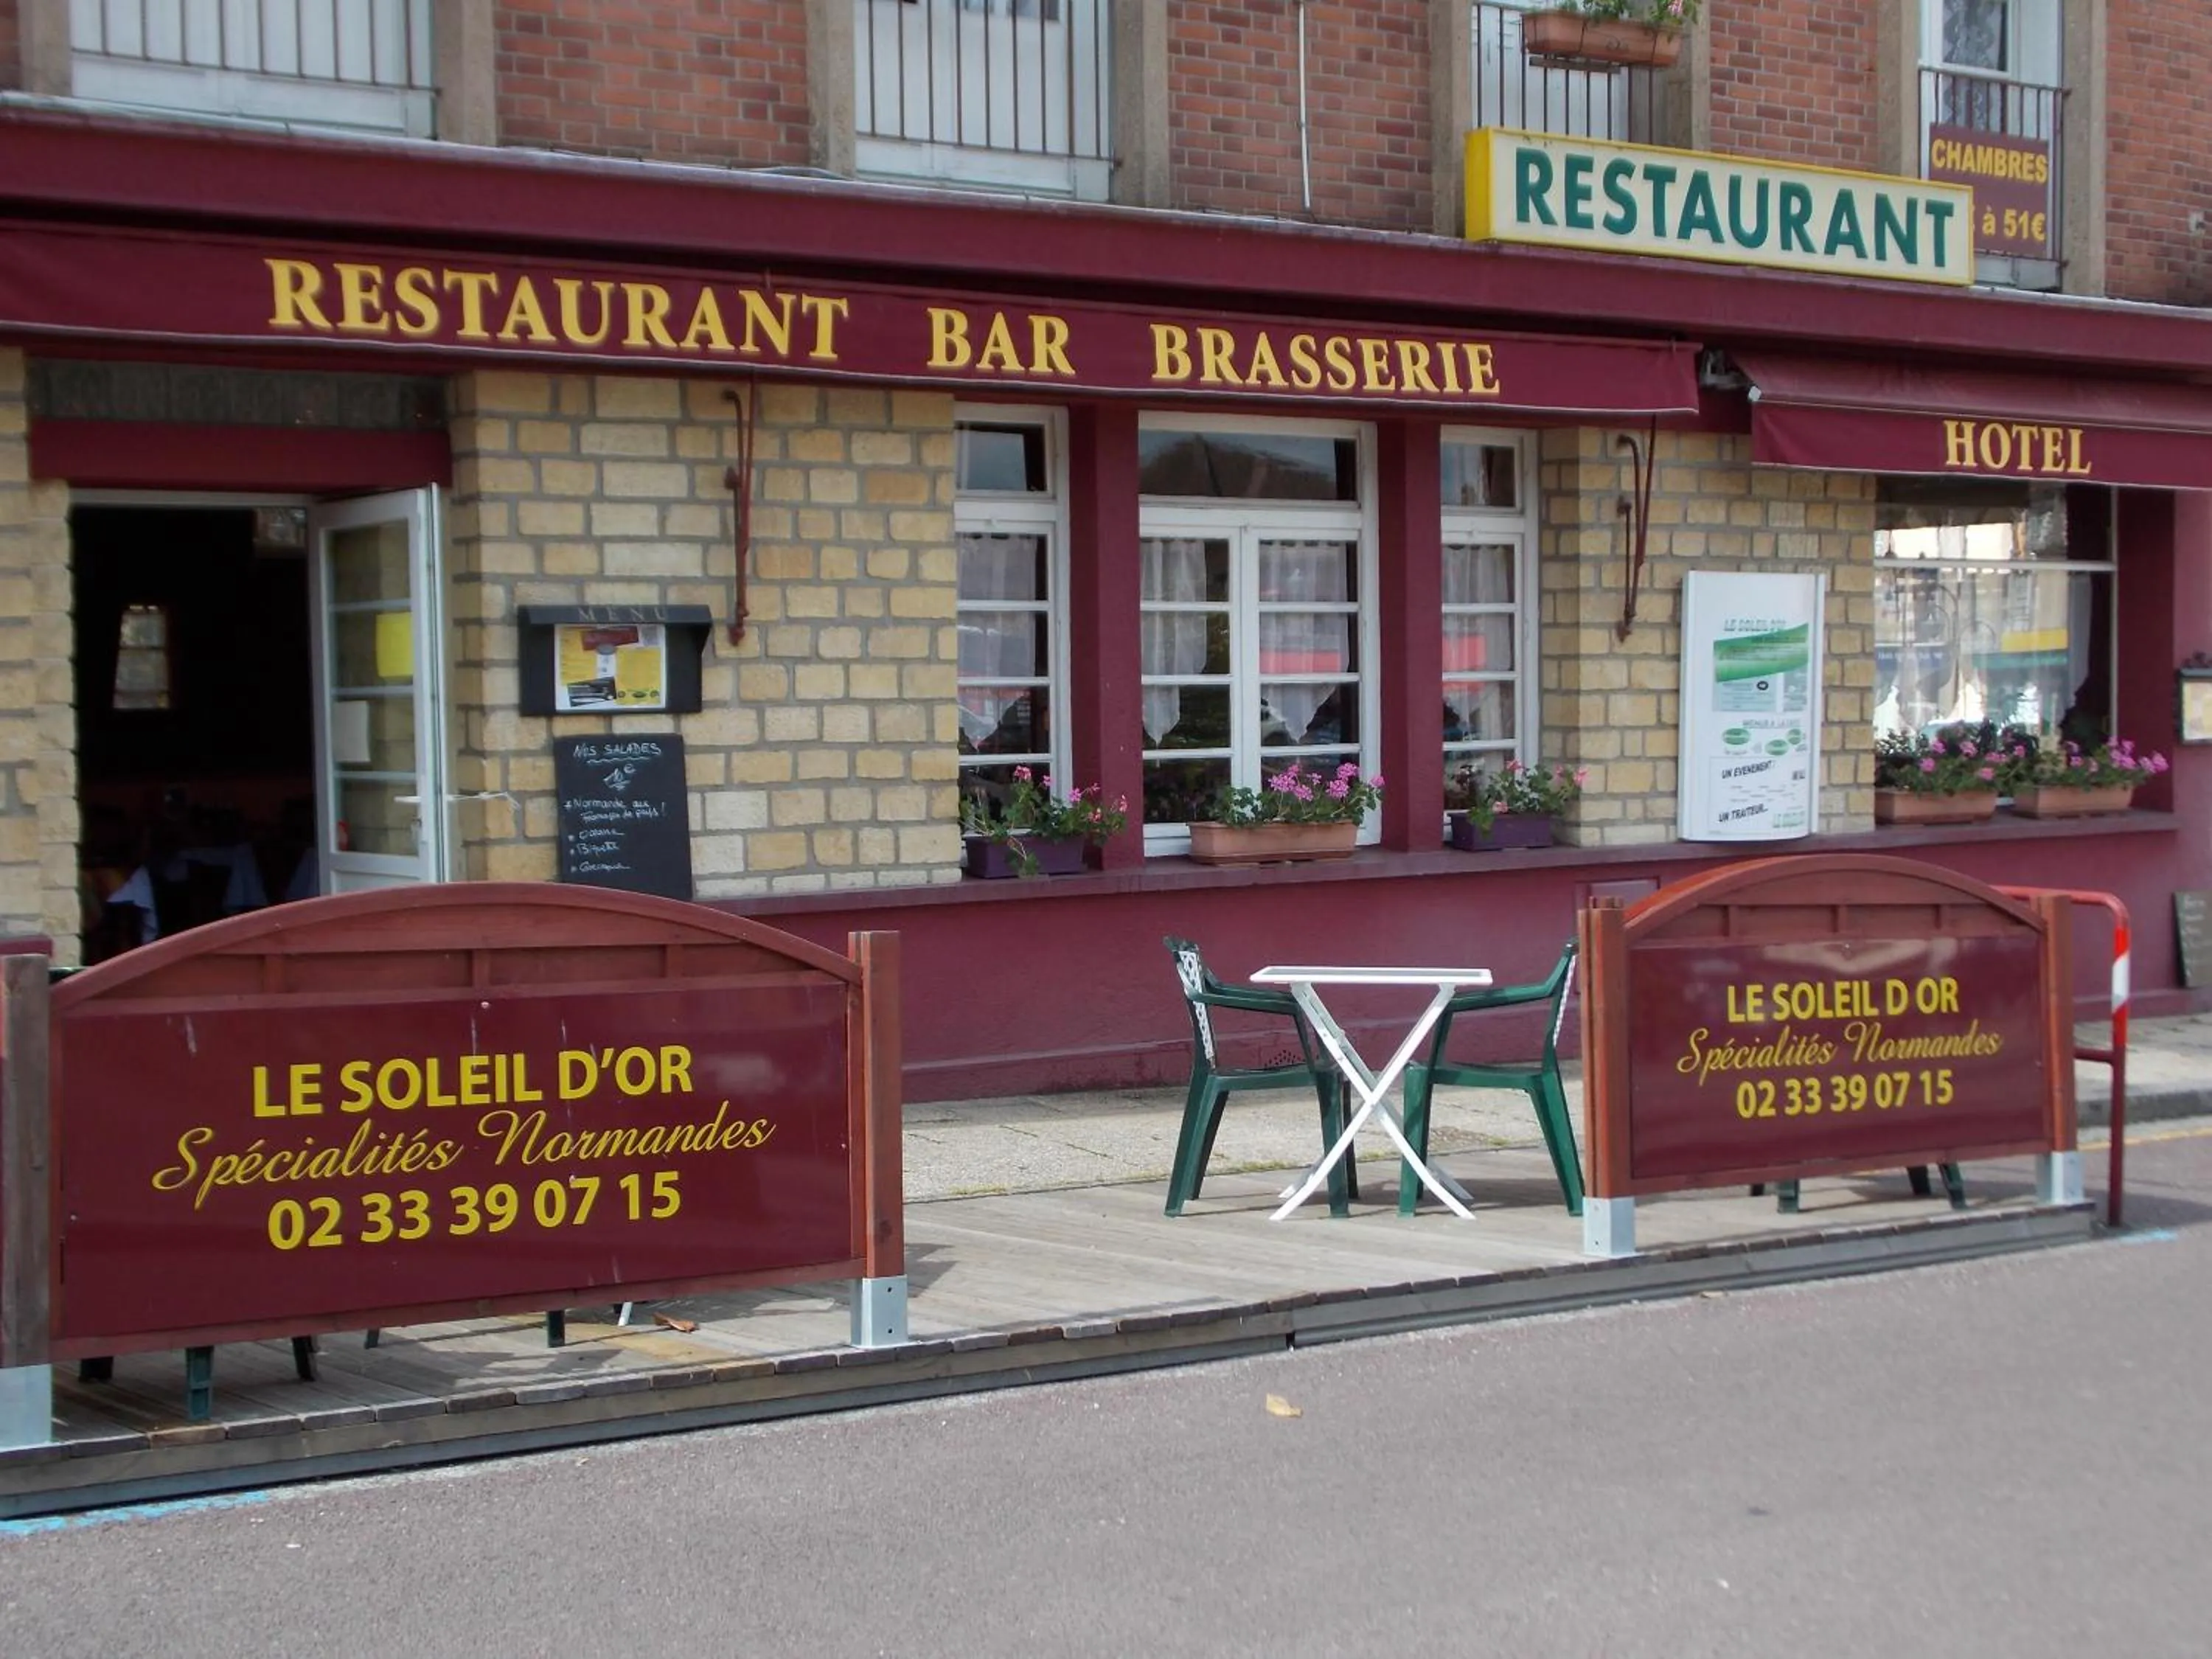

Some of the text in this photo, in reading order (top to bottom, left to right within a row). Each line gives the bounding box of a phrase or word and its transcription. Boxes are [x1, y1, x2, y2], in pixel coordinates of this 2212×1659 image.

[1931, 139, 2049, 184] CHAMBRES
[1515, 147, 1954, 268] RESTAURANT
[1982, 205, 1996, 236] à
[2003, 209, 2046, 242] 51€
[265, 258, 1500, 394] RESTAURANT BAR BRASSERIE
[1943, 420, 2092, 473] HOTEL
[578, 605, 669, 622] MENU
[603, 742, 662, 757] SALADES
[1727, 984, 1765, 1023] LE
[1773, 980, 1879, 1021] SOLEIL
[1677, 1018, 2004, 1087] Spécialités Normandes
[252, 1044, 694, 1118] LE SOLEIL D'OR
[1736, 1068, 1955, 1119] 02 33 39 07 15
[152, 1099, 777, 1211] Spécialités Normandes
[268, 1170, 682, 1251] 02 33 39 07 15
